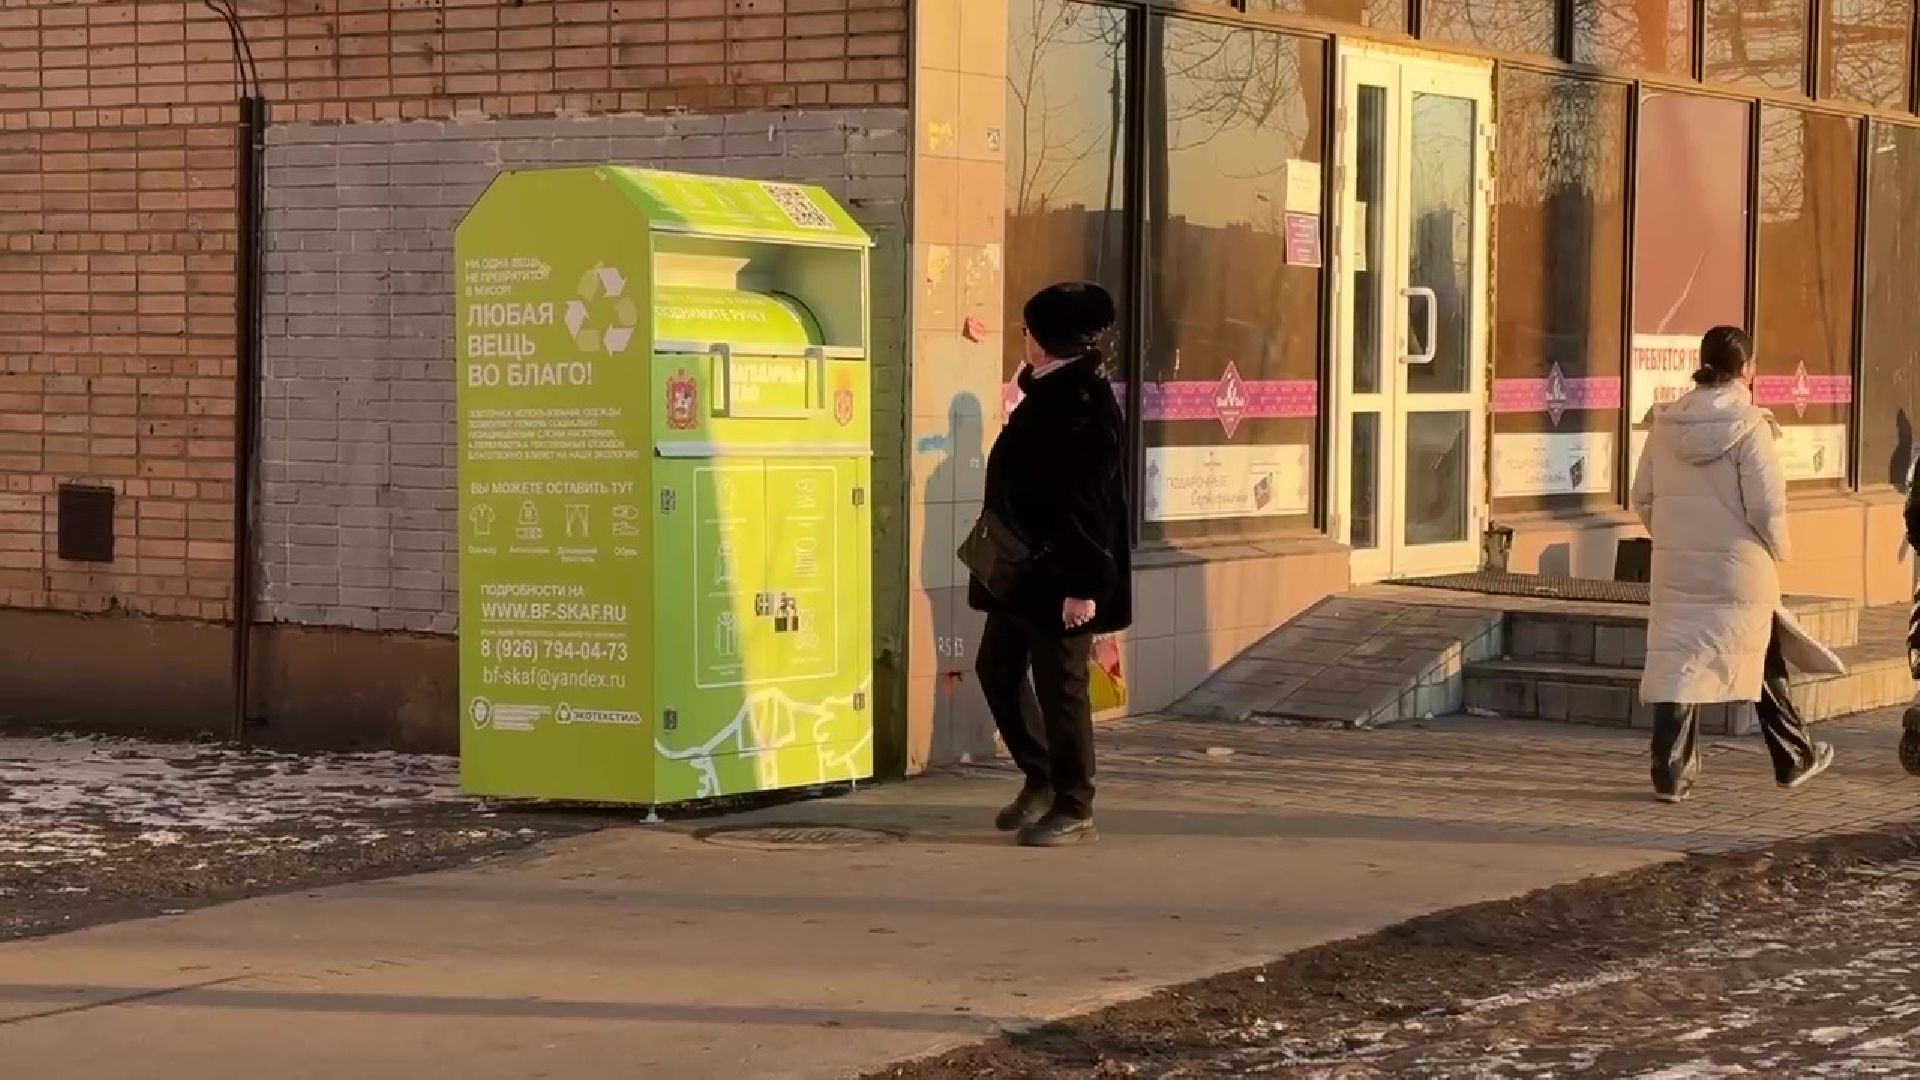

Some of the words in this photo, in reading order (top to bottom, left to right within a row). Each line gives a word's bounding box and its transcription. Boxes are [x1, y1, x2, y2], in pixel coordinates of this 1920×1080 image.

[465, 271, 479, 283] НЕ
[467, 302, 554, 328] ЛЮБАЯ
[468, 333, 536, 361] ВЕЩЬ
[468, 364, 500, 388] ВО
[507, 361, 593, 387] БЛАГО!
[471, 482, 489, 494] ВЫ
[492, 482, 544, 494] МОЖЕТЕ
[546, 481, 608, 494] ОСТАВИТЬ
[612, 481, 634, 494] ТУТ
[480, 584, 566, 597] ПОДРОБНОСТИ
[568, 586, 585, 597] НА
[481, 602, 626, 622] WWW.BF-SKAF.RU
[480, 639, 491, 658] 8
[497, 639, 538, 662] (926)
[543, 640, 628, 662] 794-04-73
[483, 665, 626, 691] bf-skaf@yandex.ru
[572, 710, 640, 723] ЭКОТЕКСТИЛЬ
